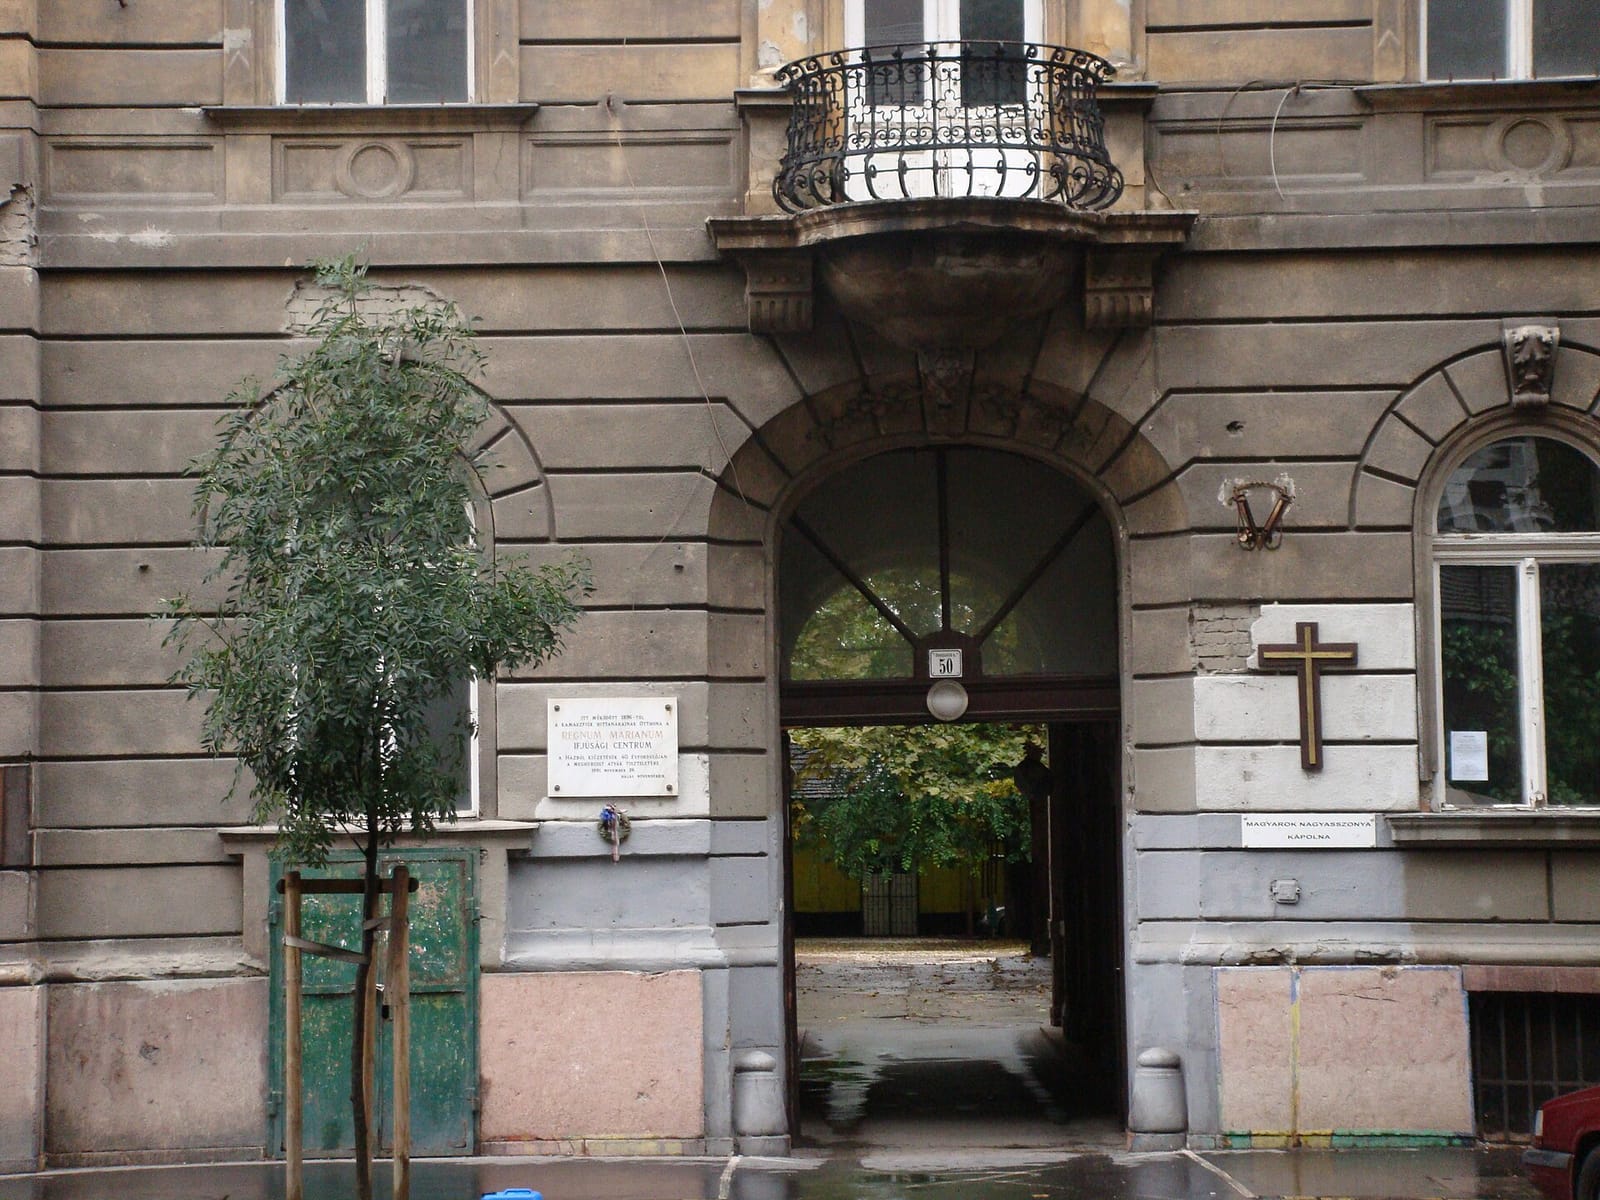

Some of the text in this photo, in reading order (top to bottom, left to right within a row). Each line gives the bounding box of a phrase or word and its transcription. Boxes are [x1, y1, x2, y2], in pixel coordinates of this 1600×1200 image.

[939, 658, 953, 674] 50
[561, 730, 664, 740] REGNUM MARIANUM
[613, 741, 652, 749] CENTRUM
